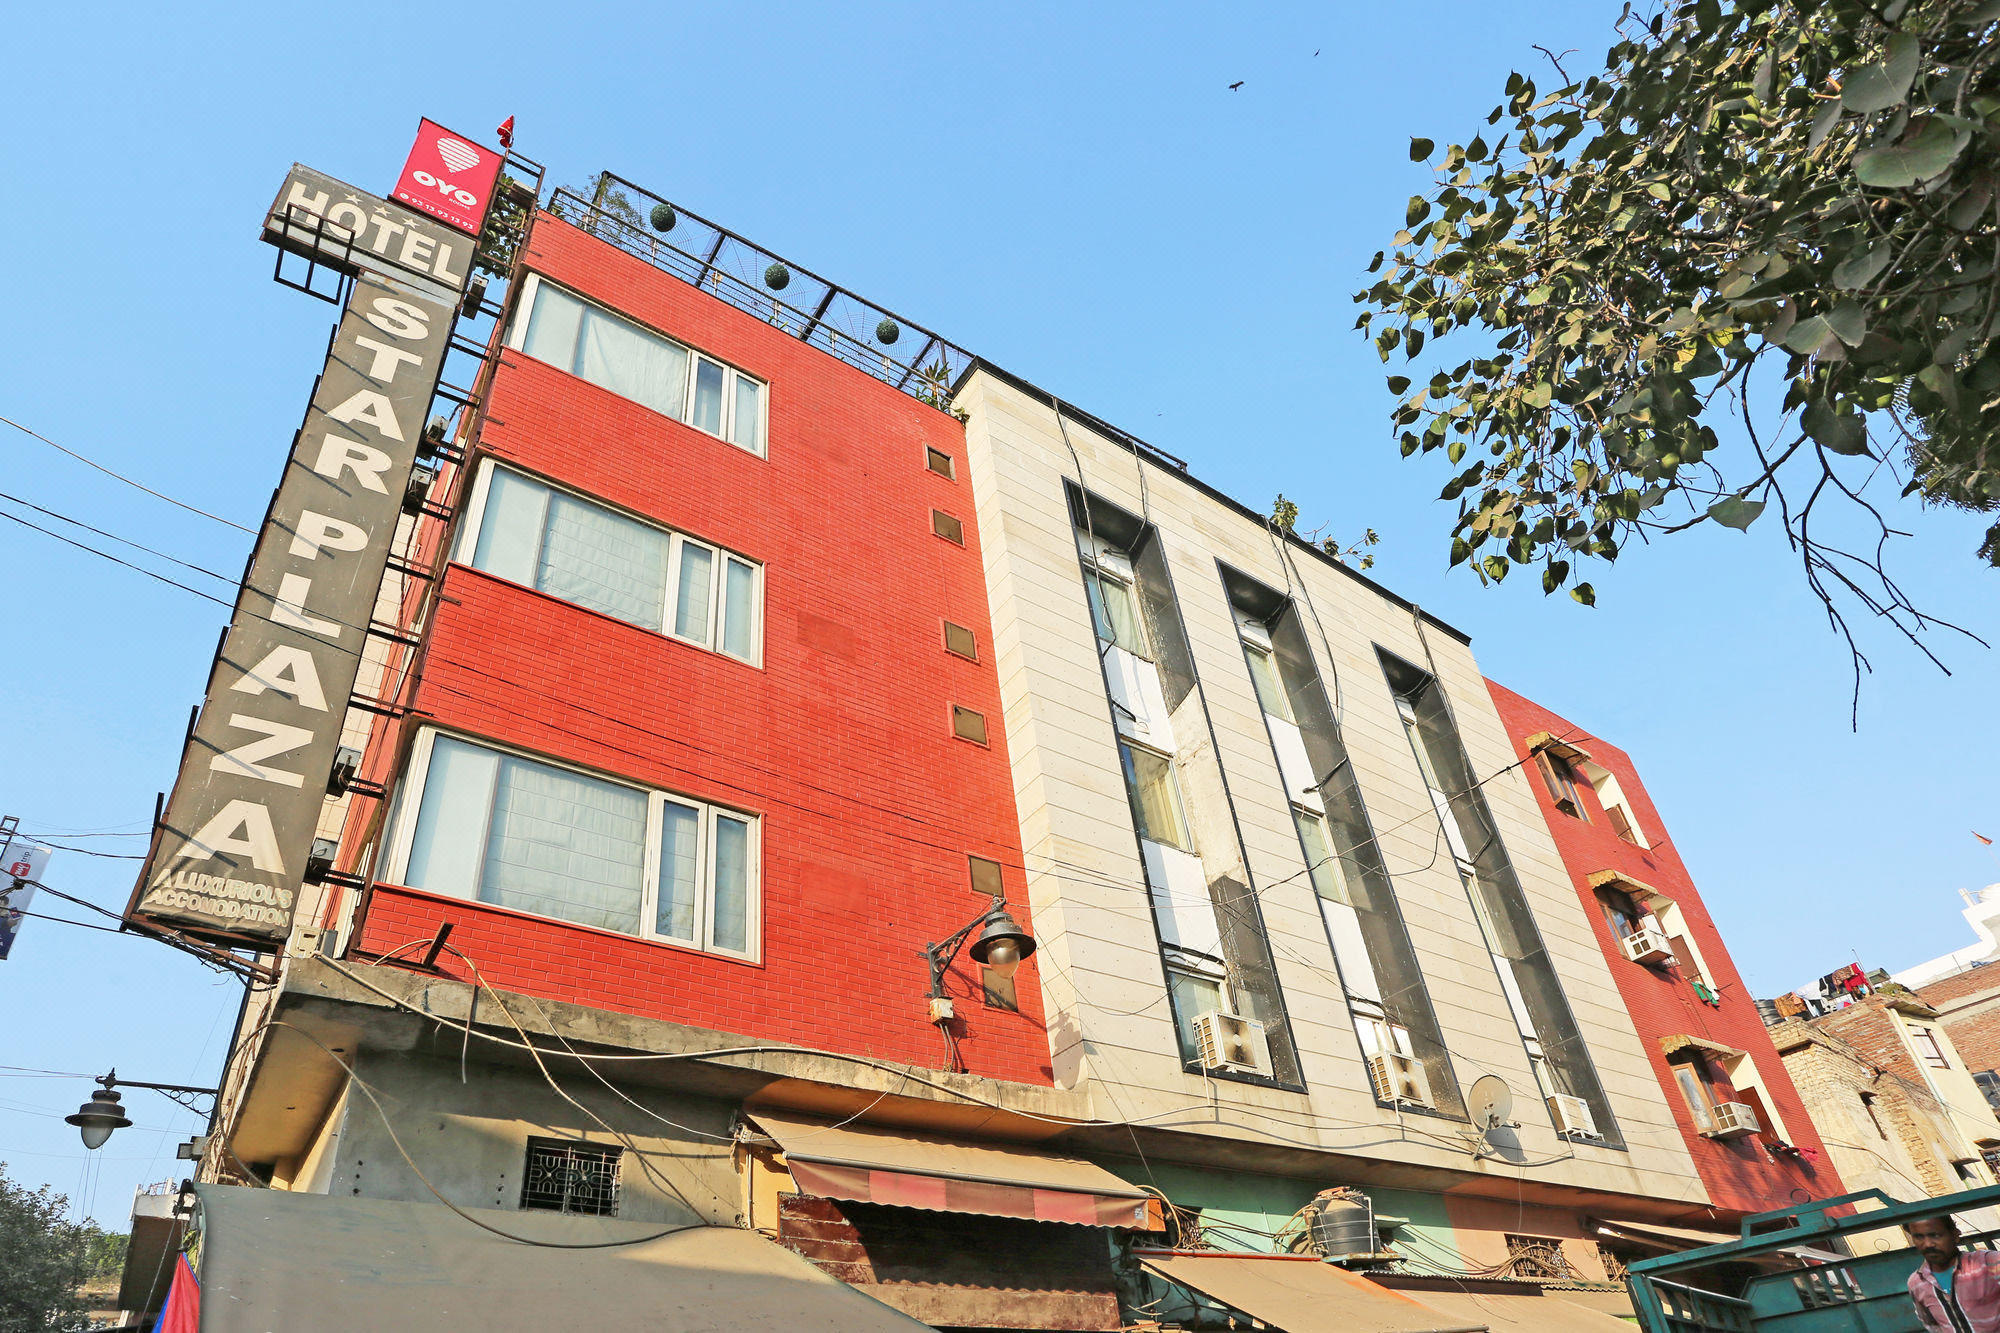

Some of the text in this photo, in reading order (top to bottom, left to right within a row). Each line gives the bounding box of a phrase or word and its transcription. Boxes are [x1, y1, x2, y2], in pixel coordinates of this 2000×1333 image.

[413, 170, 477, 206] OYO
[282, 181, 461, 286] HOTEL
[411, 198, 473, 229] 93 13 93 13 93
[176, 297, 430, 875] STAR PLAZA
[152, 868, 293, 909] A LUXURIOUS
